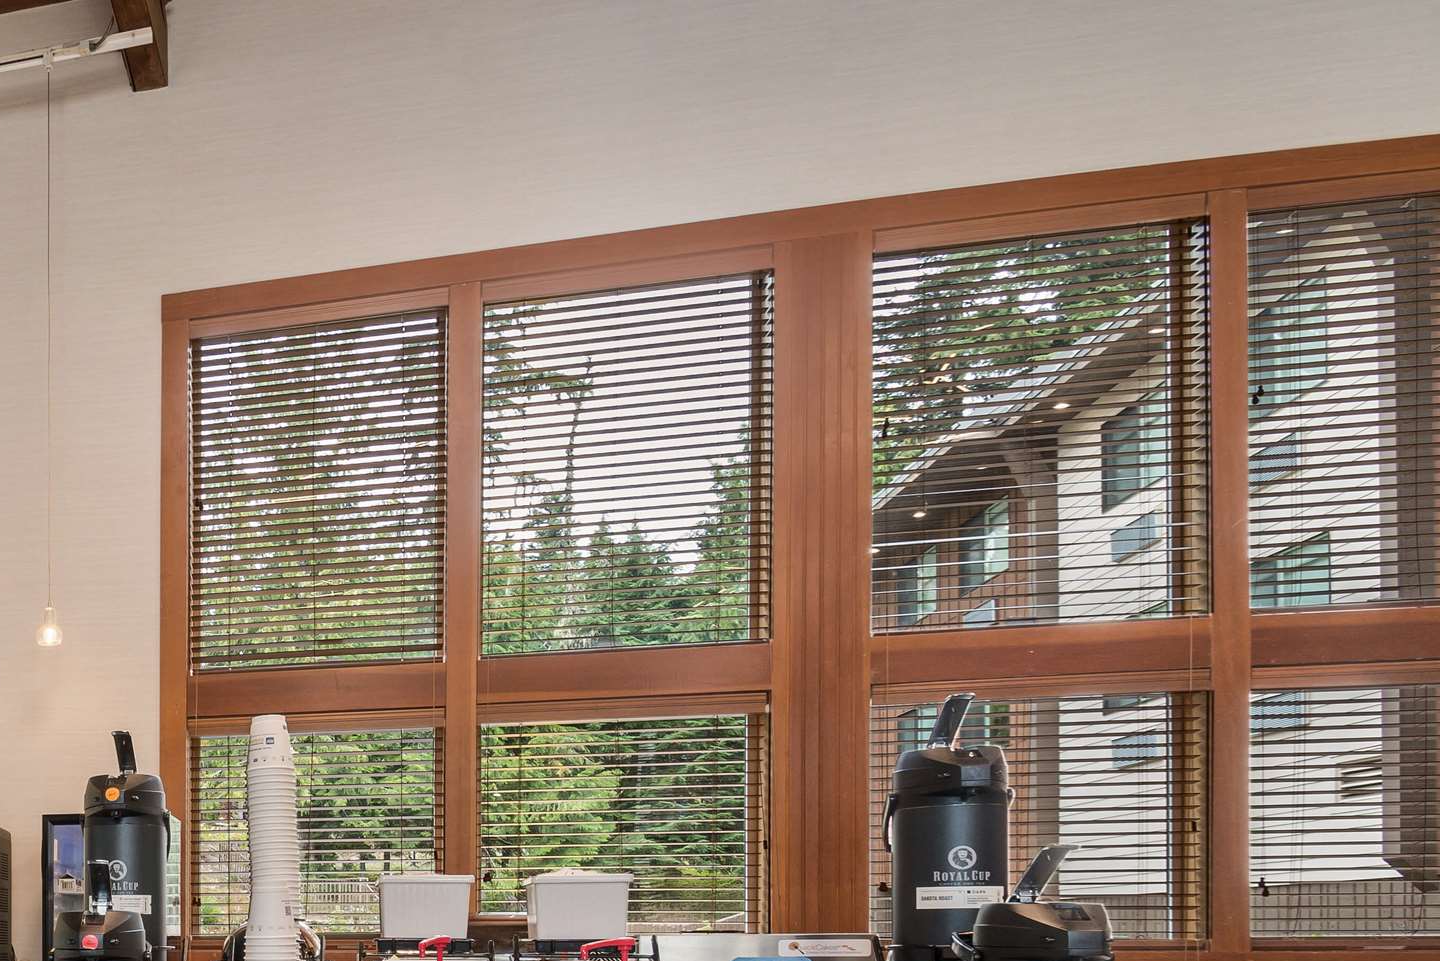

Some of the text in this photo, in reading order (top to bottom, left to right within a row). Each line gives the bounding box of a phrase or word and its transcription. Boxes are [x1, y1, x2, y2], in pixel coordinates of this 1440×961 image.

[933, 870, 991, 882] ROYAL CUP
[122, 881, 139, 891] CUP
